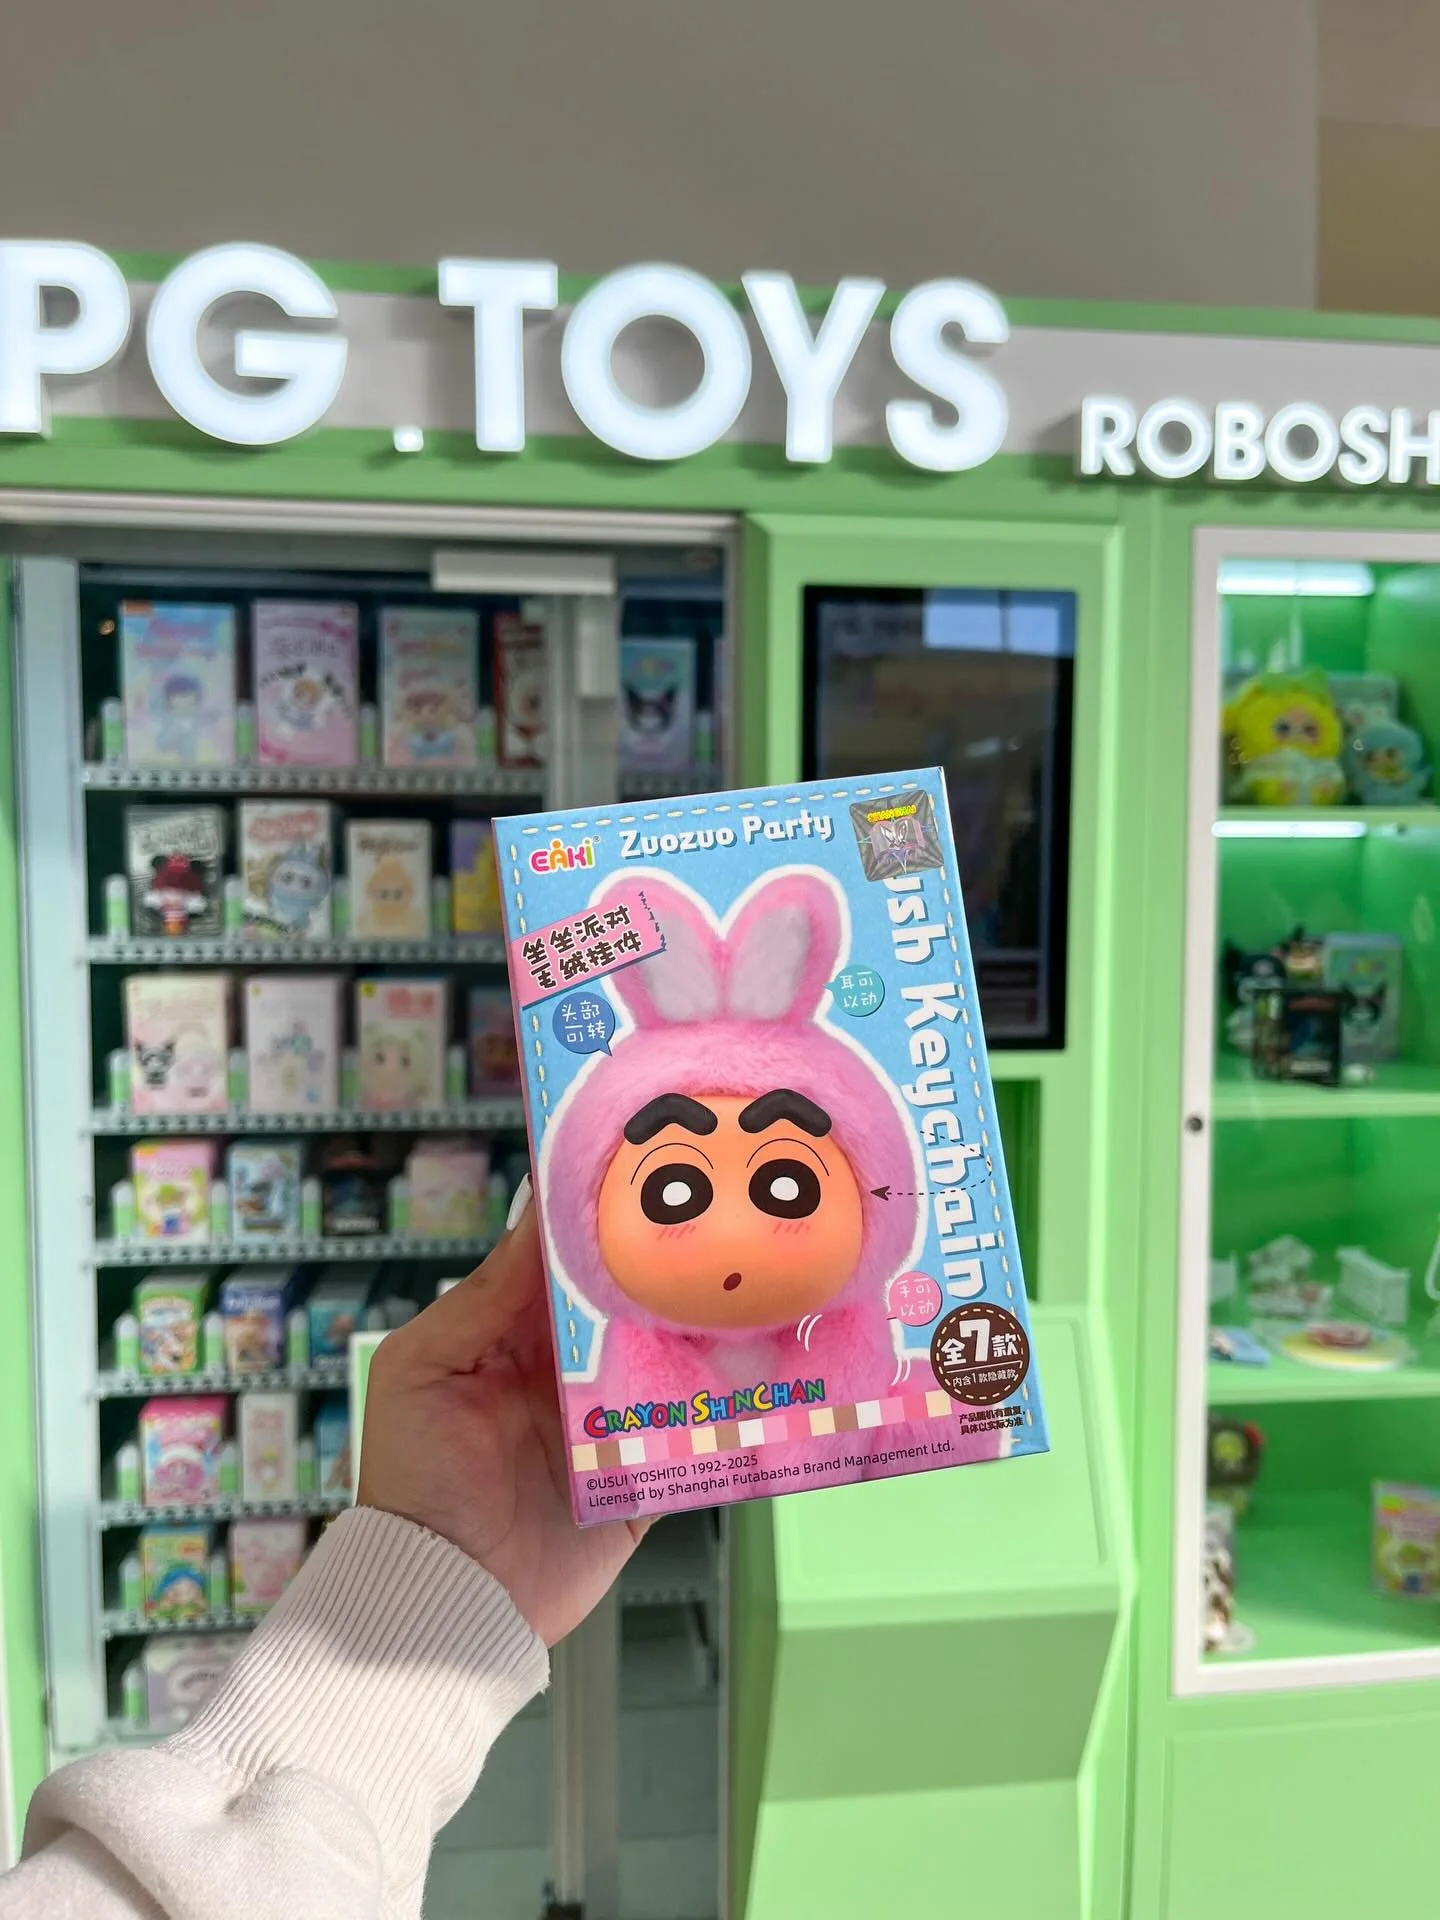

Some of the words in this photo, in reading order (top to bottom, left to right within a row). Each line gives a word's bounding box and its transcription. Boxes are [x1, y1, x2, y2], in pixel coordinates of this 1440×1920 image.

[1081, 396, 1440, 485] ROBOSH
[619, 829, 736, 859] Zuozuo
[742, 809, 835, 844] Party
[531, 930, 642, 989] 毛绒挂件
[840, 971, 873, 989] 耳可
[562, 1000, 601, 1022] 头部
[843, 991, 877, 1008] 以动
[564, 1020, 606, 1042] 可转
[900, 982, 999, 1299] Keychain
[941, 1318, 1019, 1367] 全7款
[584, 1400, 688, 1439] CRAYON
[589, 1488, 646, 1507] Licensed
[649, 1486, 665, 1501] by
[668, 1476, 730, 1497] Shanghai
[733, 1466, 801, 1486] Futabasha
[804, 1457, 841, 1475] Brand
[844, 1446, 929, 1467] Management
[931, 1440, 955, 1454] Ltd.
[631, 1465, 687, 1484] YOSHITO
[690, 1454, 758, 1475] 1992-2025
